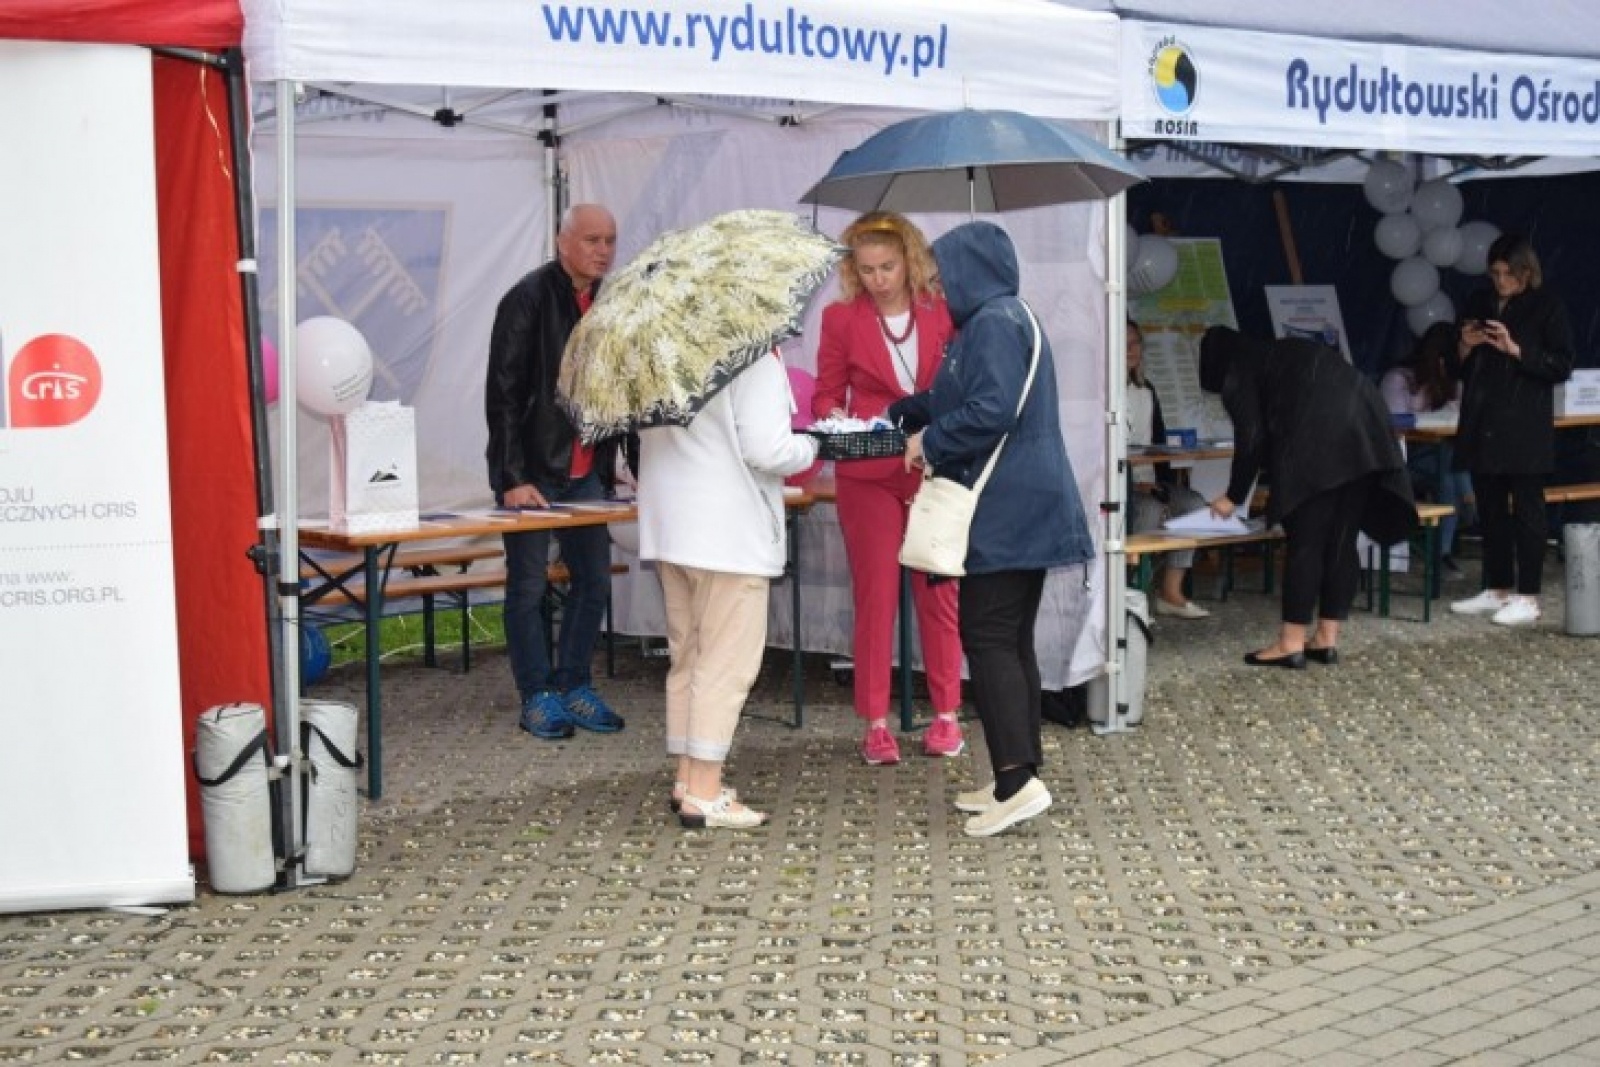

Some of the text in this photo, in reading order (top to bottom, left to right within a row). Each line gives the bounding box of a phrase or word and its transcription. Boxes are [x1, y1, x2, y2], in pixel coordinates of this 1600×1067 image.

[541, 2, 948, 77] www.rydultowy.pl
[1286, 57, 1499, 125] Rydułtowski
[91, 501, 137, 520] CRIS
